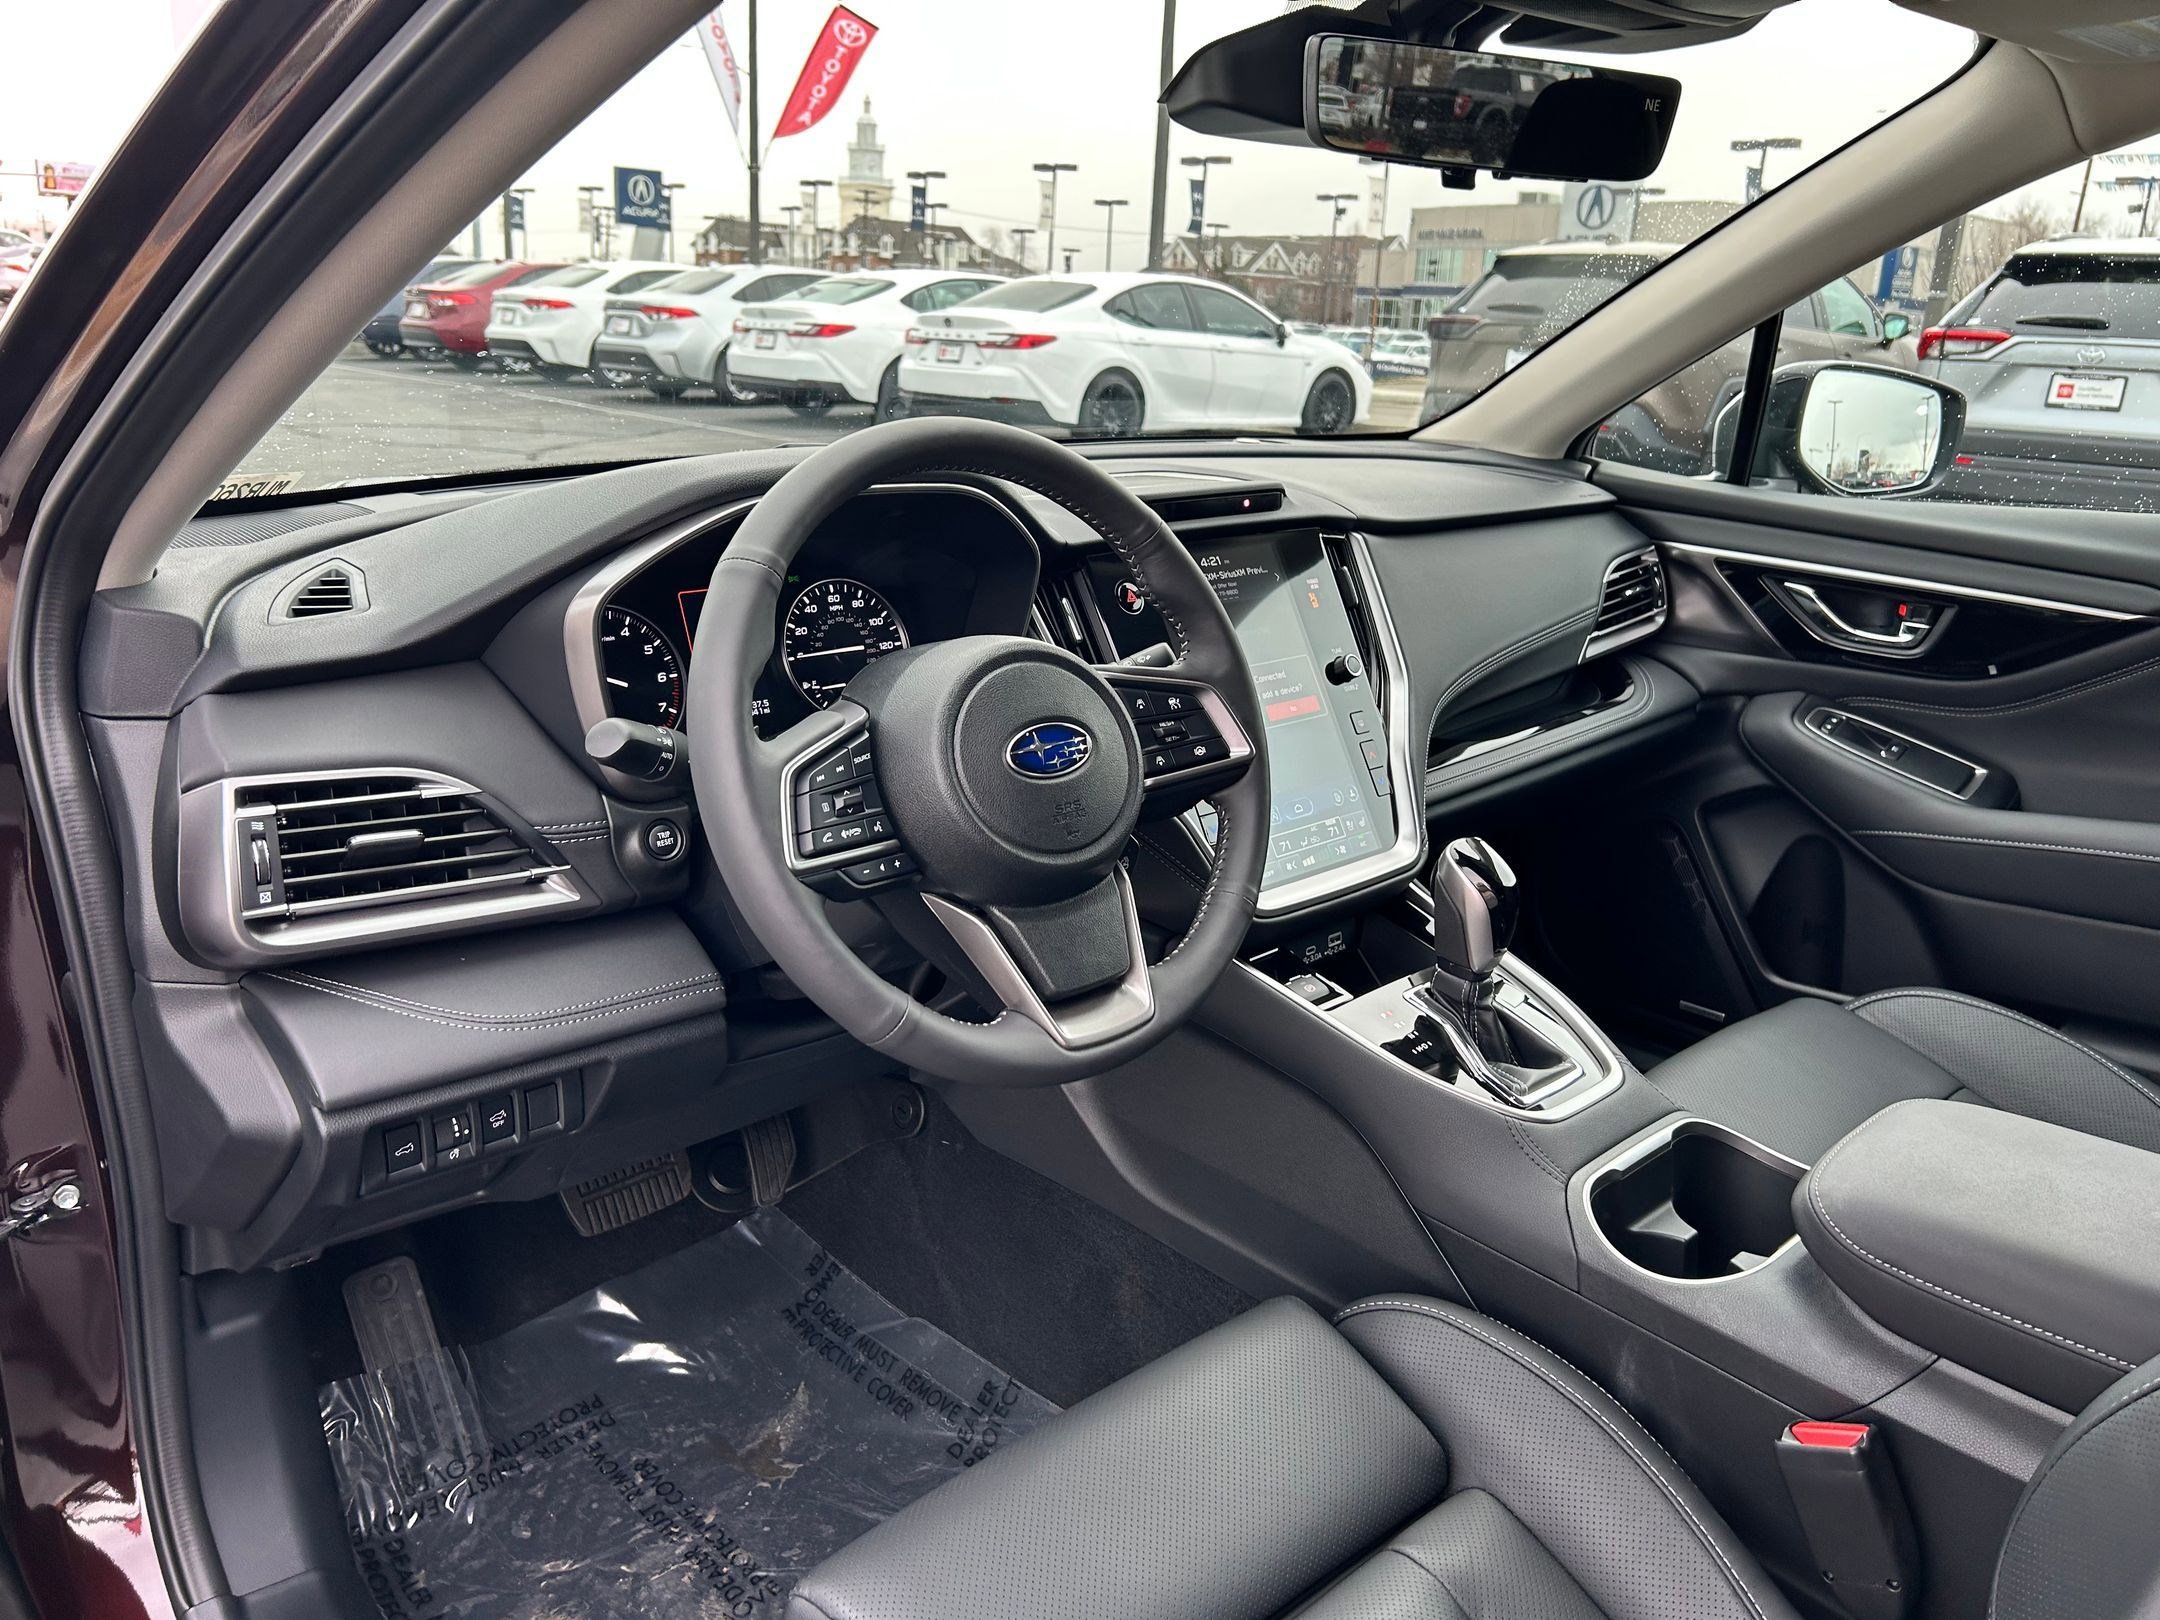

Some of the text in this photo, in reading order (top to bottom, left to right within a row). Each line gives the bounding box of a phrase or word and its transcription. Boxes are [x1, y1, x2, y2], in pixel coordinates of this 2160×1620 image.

[797, 44, 847, 127] TOYOTA
[1644, 97, 1661, 112] NE
[1200, 555, 1222, 567] 4:21
[828, 595, 840, 603] 60
[852, 600, 864, 608] 80
[804, 604, 817, 613] 40
[869, 617, 883, 626] 100
[620, 626, 631, 638] 4
[795, 627, 808, 635] 20
[644, 644, 654, 656] 5
[879, 641, 893, 650] 120
[657, 671, 668, 684] 6
[1253, 669, 1287, 684] Connected
[658, 701, 668, 713] 7
[661, 751, 674, 760] AUTO
[853, 753, 872, 764] SOURCE
[1054, 801, 1083, 815] SRS
[657, 830, 671, 839] TRIP
[1327, 826, 1340, 838] 71
[656, 838, 675, 848] RESET
[1278, 841, 1292, 853] 71
[492, 1119, 505, 1129] OFF
[796, 1317, 915, 1424] PROTECTIVE COVER
[854, 1334, 899, 1370] MUST
[900, 1366, 963, 1426] REMOVE
[538, 1410, 617, 1461] DEALER
